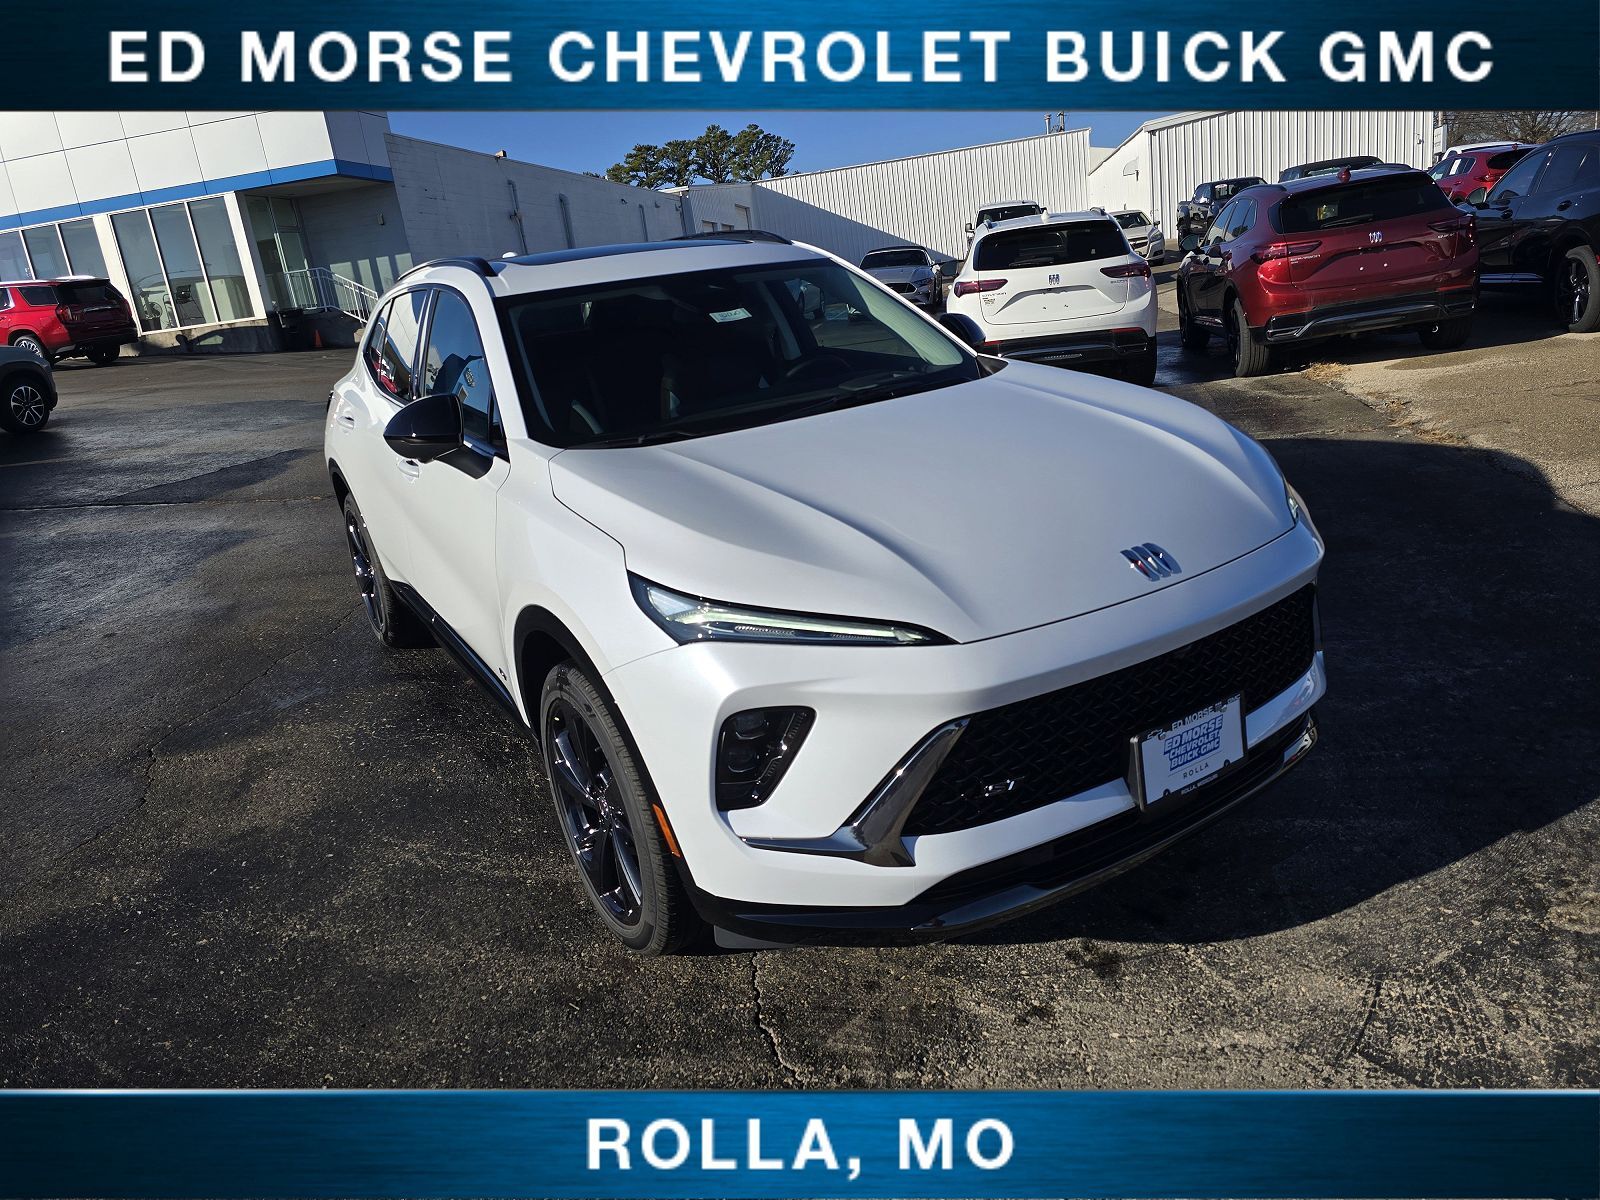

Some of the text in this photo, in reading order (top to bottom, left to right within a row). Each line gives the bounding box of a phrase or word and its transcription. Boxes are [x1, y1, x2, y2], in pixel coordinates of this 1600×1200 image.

[1171, 719, 1183, 731] ED
[1184, 706, 1214, 726] MORSE
[1164, 715, 1223, 756] ED MORSE
[1169, 731, 1220, 760] CHEVROLET
[1182, 762, 1210, 780] ROLLA
